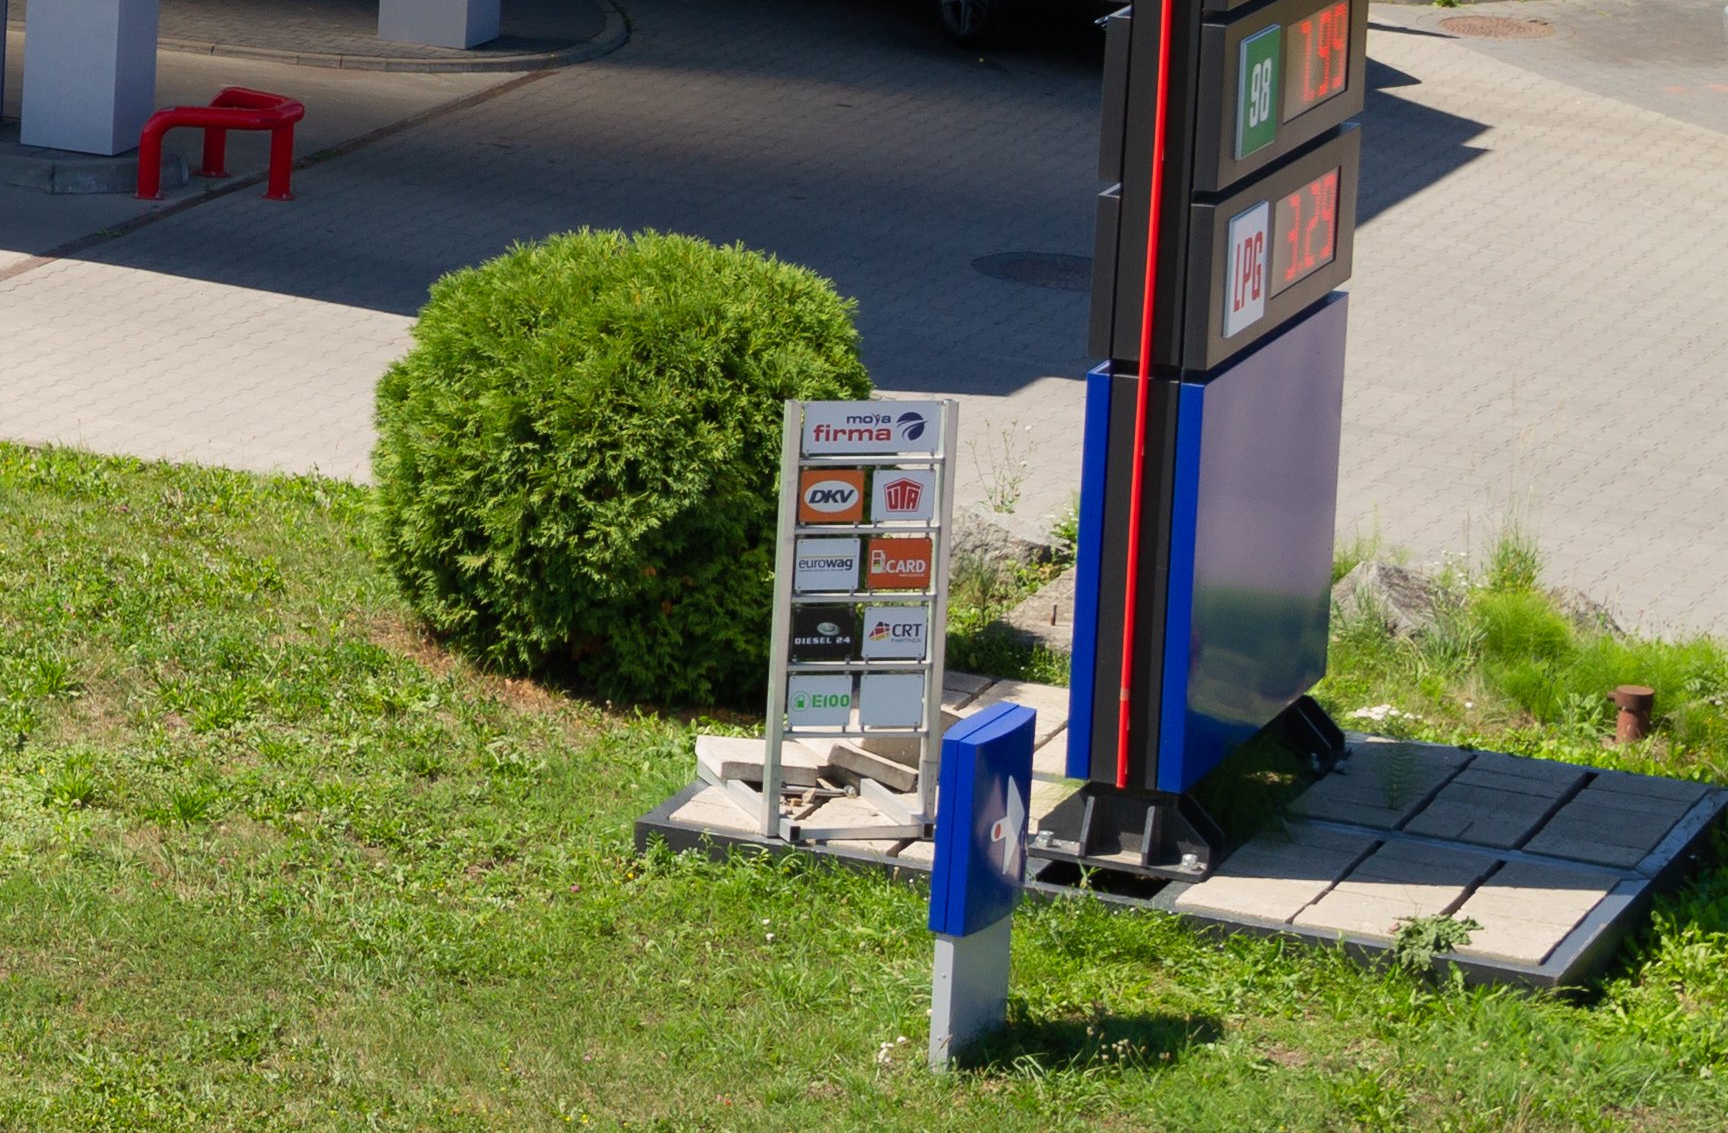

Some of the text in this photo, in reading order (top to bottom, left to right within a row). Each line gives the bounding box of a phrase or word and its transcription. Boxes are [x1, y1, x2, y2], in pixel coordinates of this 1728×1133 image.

[1249, 57, 1273, 129] 98
[1233, 230, 1263, 312] LPG
[846, 413, 892, 428] moya
[813, 424, 892, 443] firma
[807, 488, 855, 504] DKV
[885, 478, 923, 511] UTA
[798, 557, 853, 571] eurowag
[885, 559, 926, 574] CARD
[891, 623, 923, 638] CRT
[794, 636, 851, 645] DIESEL 24
[812, 694, 850, 708] E100
